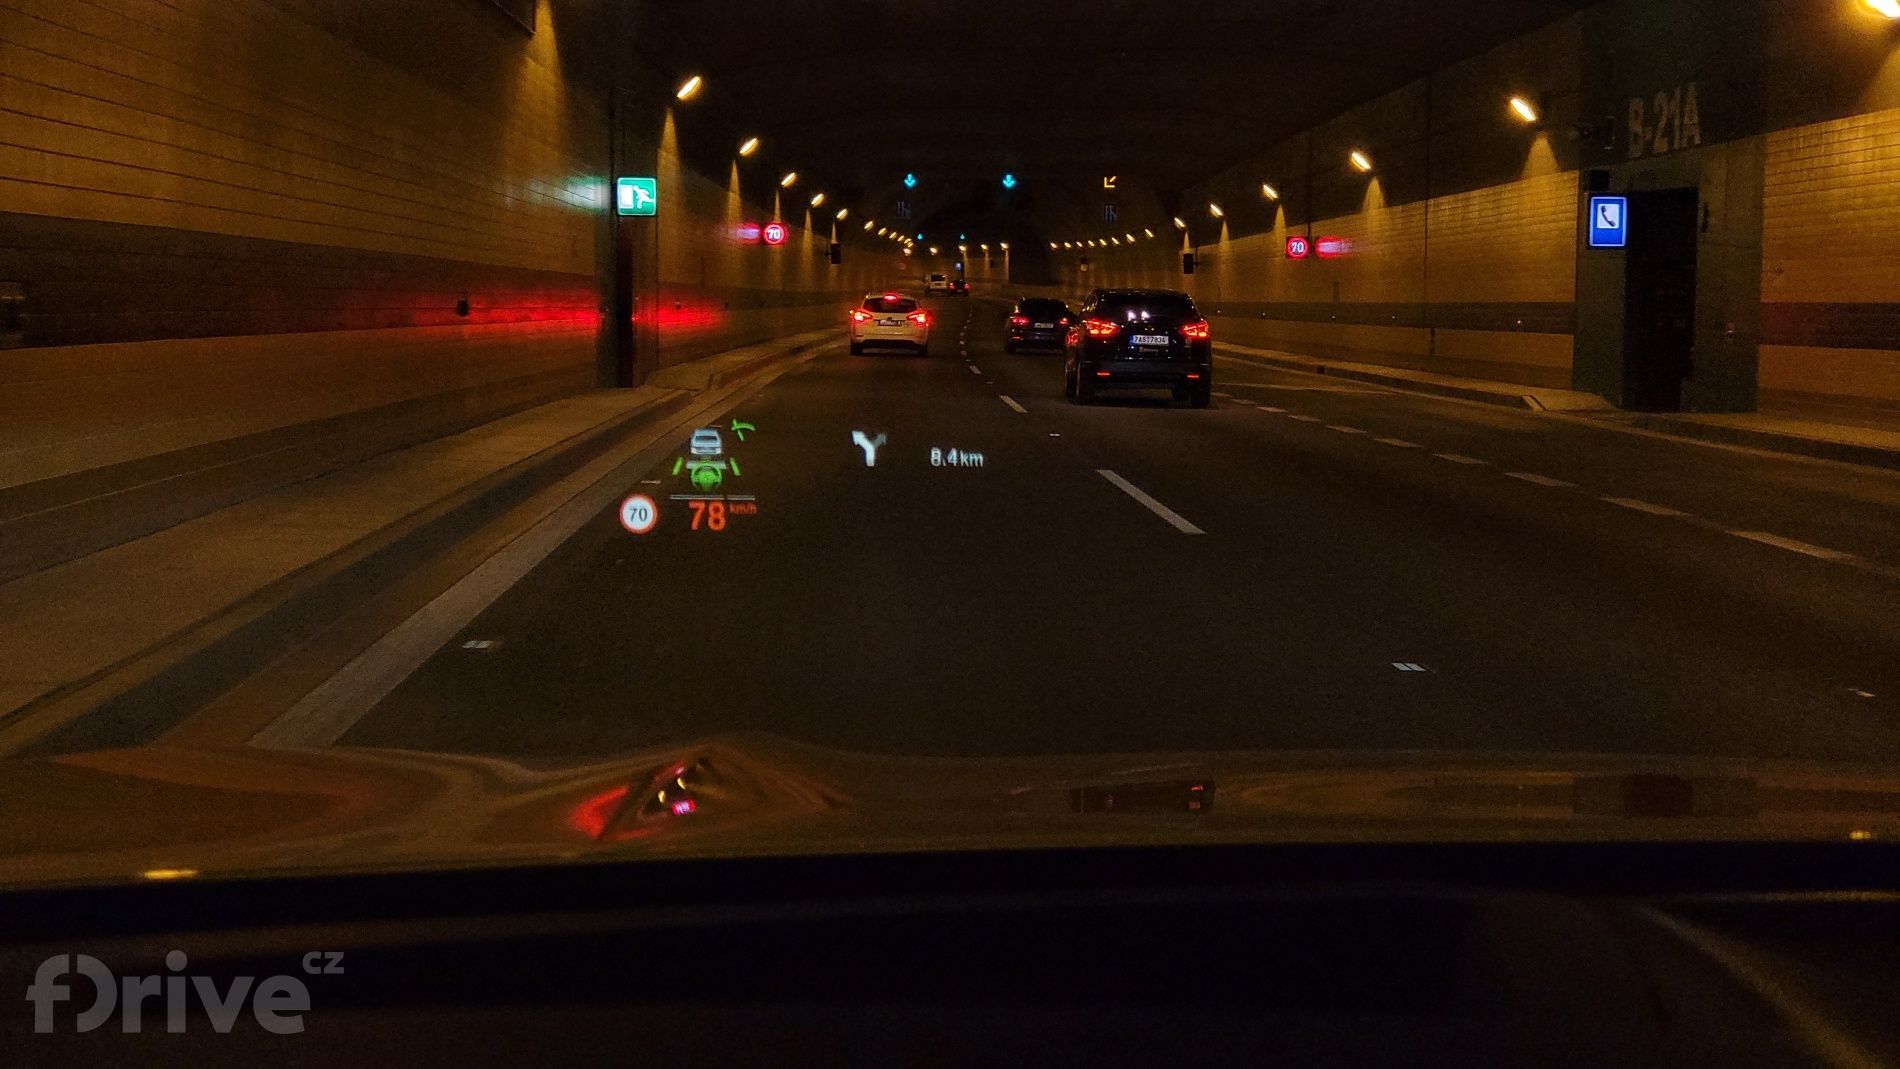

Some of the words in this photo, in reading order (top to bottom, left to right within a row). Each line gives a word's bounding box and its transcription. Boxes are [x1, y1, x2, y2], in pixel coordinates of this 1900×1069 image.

[1628, 83, 1701, 157] B-21A
[767, 228, 781, 240] 70
[1291, 241, 1304, 253] 70
[629, 507, 648, 522] 70
[688, 500, 726, 530] 78
